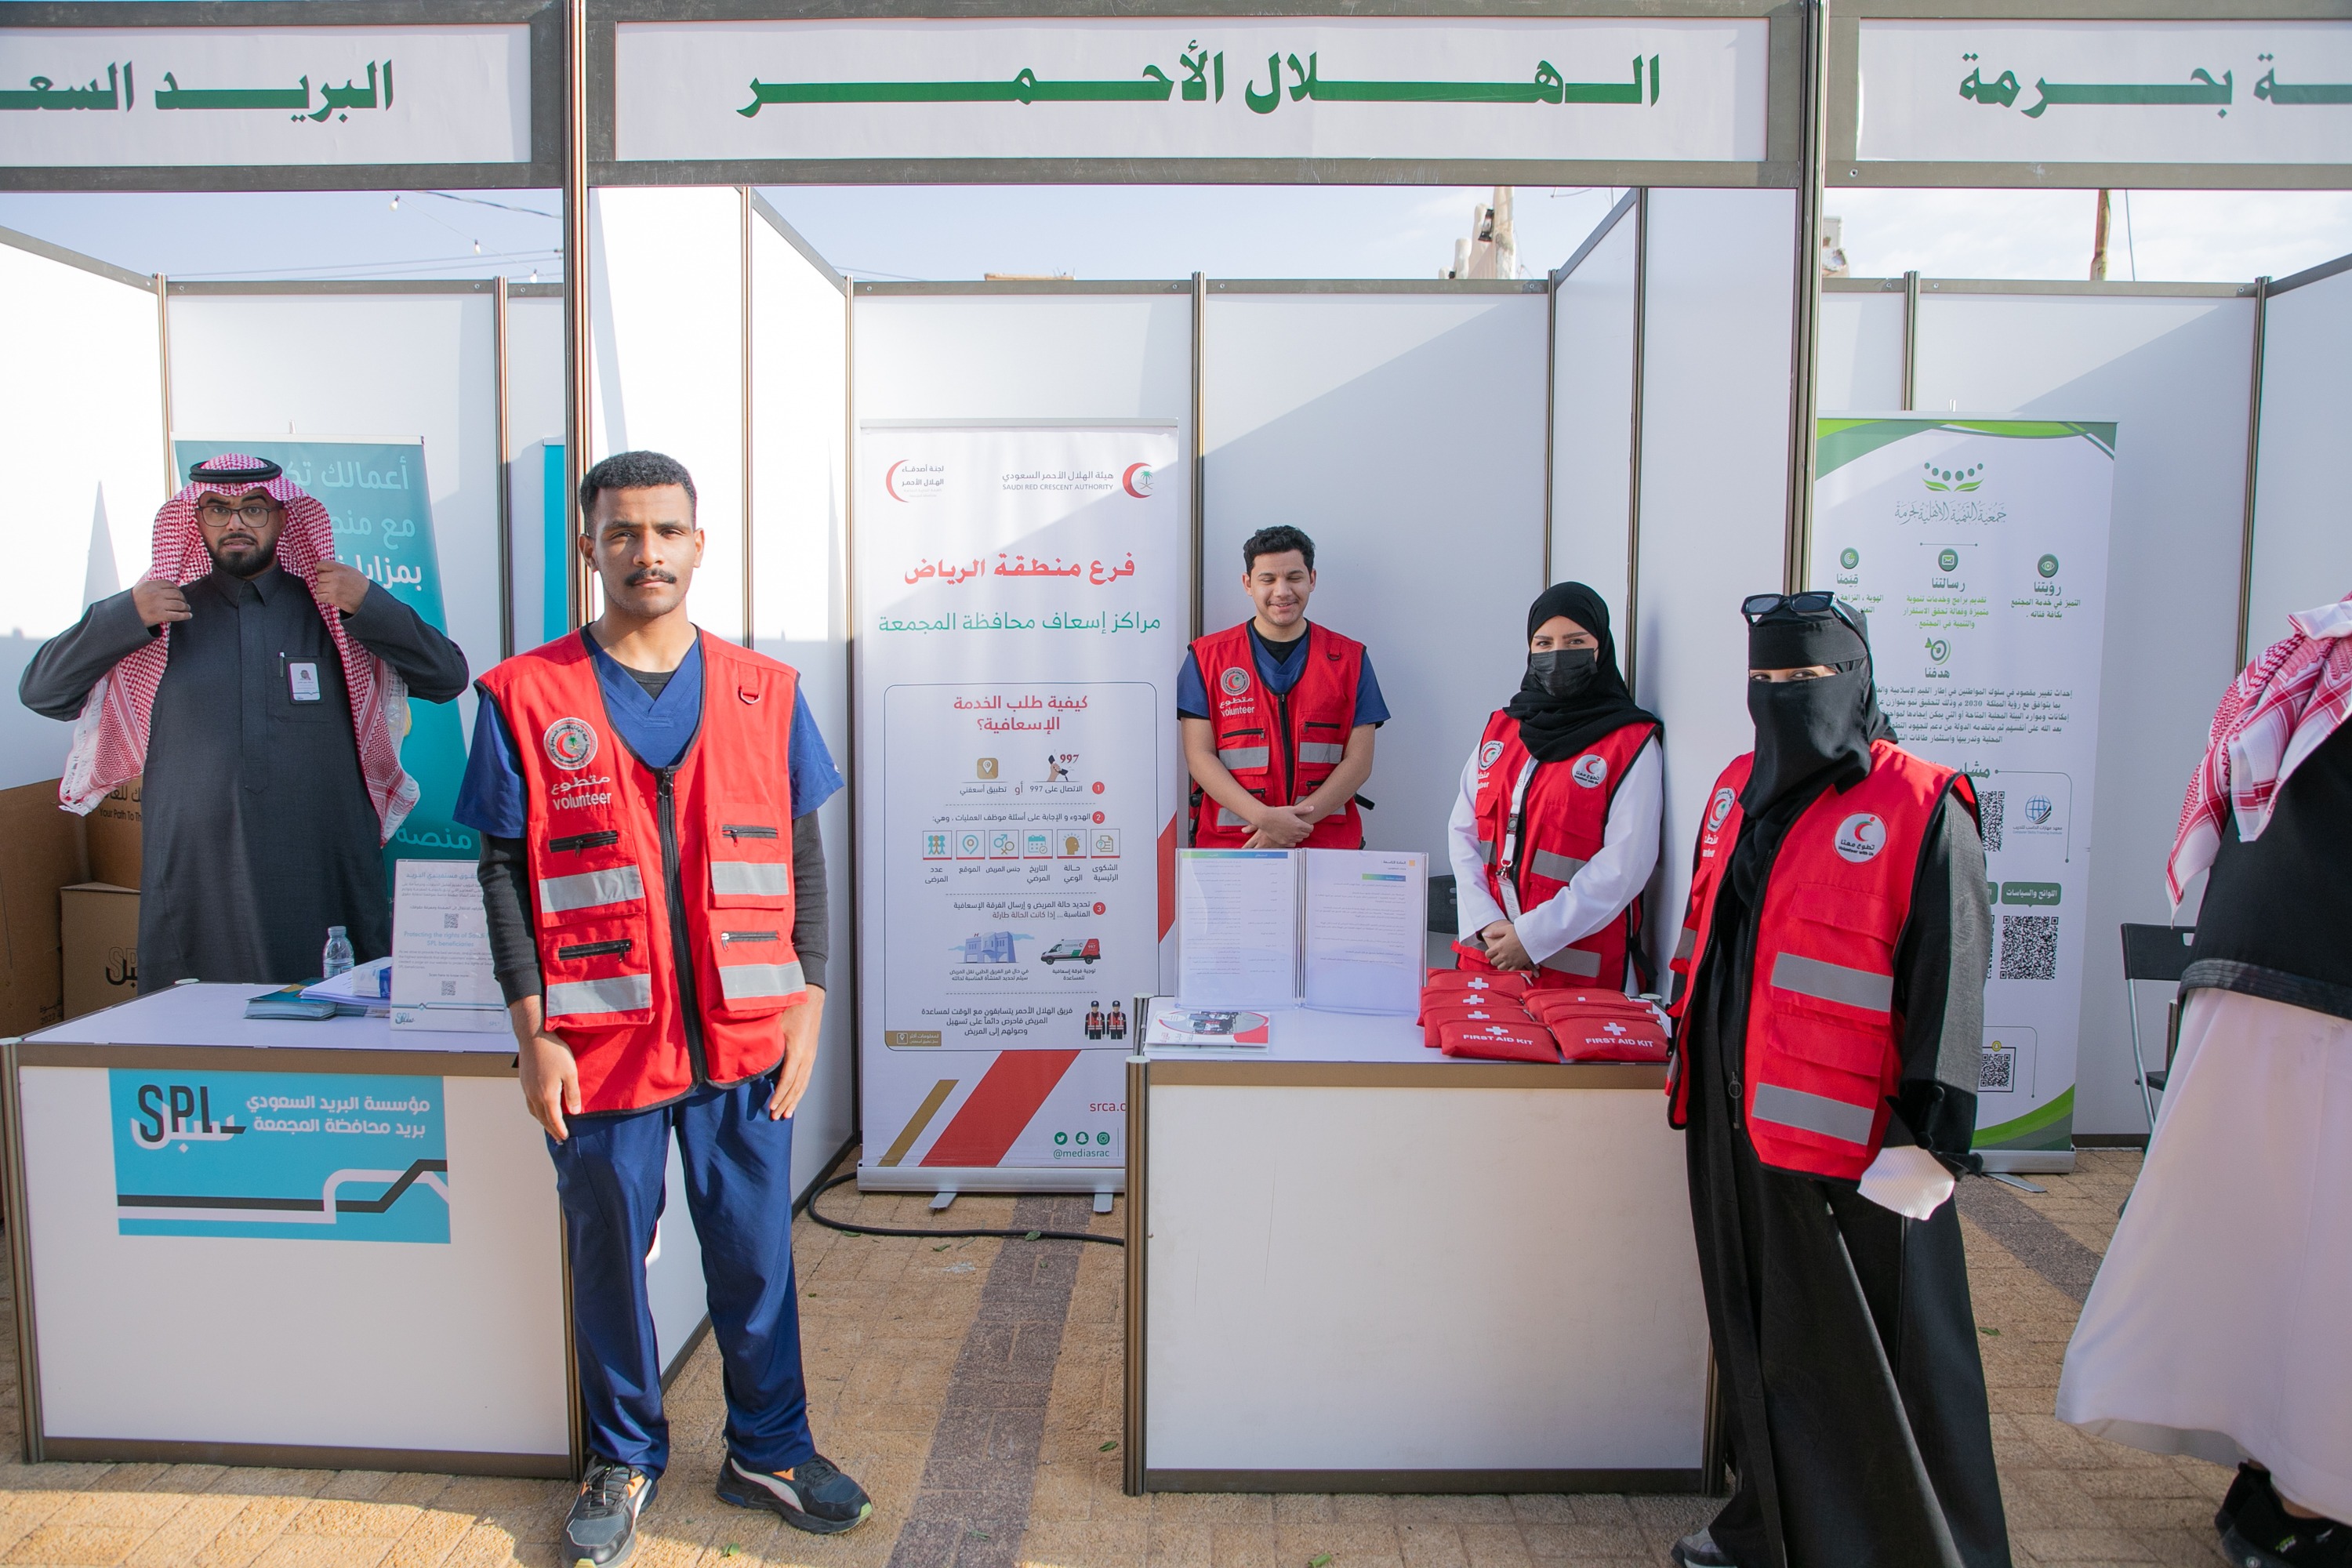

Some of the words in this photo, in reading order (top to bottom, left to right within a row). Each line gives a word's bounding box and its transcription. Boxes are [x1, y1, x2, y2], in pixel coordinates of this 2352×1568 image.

[736, 38, 1223, 118] الأحمر
[1244, 52, 1661, 115] الهلال
[0, 60, 133, 112] السع
[155, 60, 394, 123] البريد
[1958, 53, 2232, 118] بجرمة
[321, 456, 408, 489] أعمالك
[1002, 471, 1040, 482] السعودي
[1042, 471, 1066, 481] الأحمر
[1068, 471, 1093, 481] الهلال
[1095, 471, 1113, 481] هيئة
[902, 478, 922, 487] الأحمر
[331, 510, 372, 535] منص
[382, 517, 415, 550] مع
[905, 557, 985, 586] الرياض
[994, 554, 1081, 577] منطقة
[1089, 552, 1135, 586] فرع
[1932, 578, 1965, 592] رسالتنا
[2034, 582, 2061, 596] رؤيتنا
[2011, 598, 2033, 608] المجتمع
[2054, 599, 2062, 609] في
[878, 612, 956, 635] المجمعة
[963, 612, 1035, 630] محافظة
[1042, 612, 1106, 634] إسعاف
[1112, 612, 1161, 633] مراكز
[1925, 667, 1950, 679] هدفنا
[953, 695, 1001, 710] الخدمة
[1007, 695, 1043, 712] طلب
[1047, 695, 1088, 712] كيفية
[1220, 697, 1254, 709] متطوع
[1221, 706, 1254, 717] volunteer
[977, 717, 1060, 735] الإسعافية؟
[1060, 754, 1080, 764] 997
[550, 774, 611, 796] متطوع
[960, 785, 985, 796] أسعفني
[986, 786, 1007, 794] تطبيق
[1015, 781, 1023, 795] أو
[553, 793, 612, 811] volunteer
[99, 807, 112, 817] Your
[114, 809, 126, 819] Path
[127, 811, 134, 821] To
[1008, 812, 1025, 821] أسئلة
[1042, 813, 1062, 822] الإجابة
[1029, 865, 1047, 873] التاريخ
[1092, 864, 1118, 873] الشكوى
[924, 876, 949, 884] المرضى
[1027, 875, 1051, 884] المرضي
[1063, 875, 1083, 884] الوعي
[2006, 889, 2037, 898] والسياسات
[2038, 889, 2057, 899] اللوائح
[953, 902, 985, 911] الإسعافية
[1007, 901, 1025, 911] إرسال
[1033, 901, 1056, 909] المريض
[109, 946, 137, 978] SP
[984, 1007, 1014, 1016] يتسابقون
[1015, 1007, 1035, 1015] الأحمر
[246, 1094, 314, 1113] السعودي
[319, 1097, 359, 1114] البريد
[364, 1096, 430, 1114] مؤسسة
[137, 1083, 246, 1143] SPL
[253, 1119, 319, 1135] المجمعة
[325, 1119, 390, 1134] محافظة
[395, 1121, 426, 1138] بريد
[1053, 1148, 1110, 1160] @mediasrac
